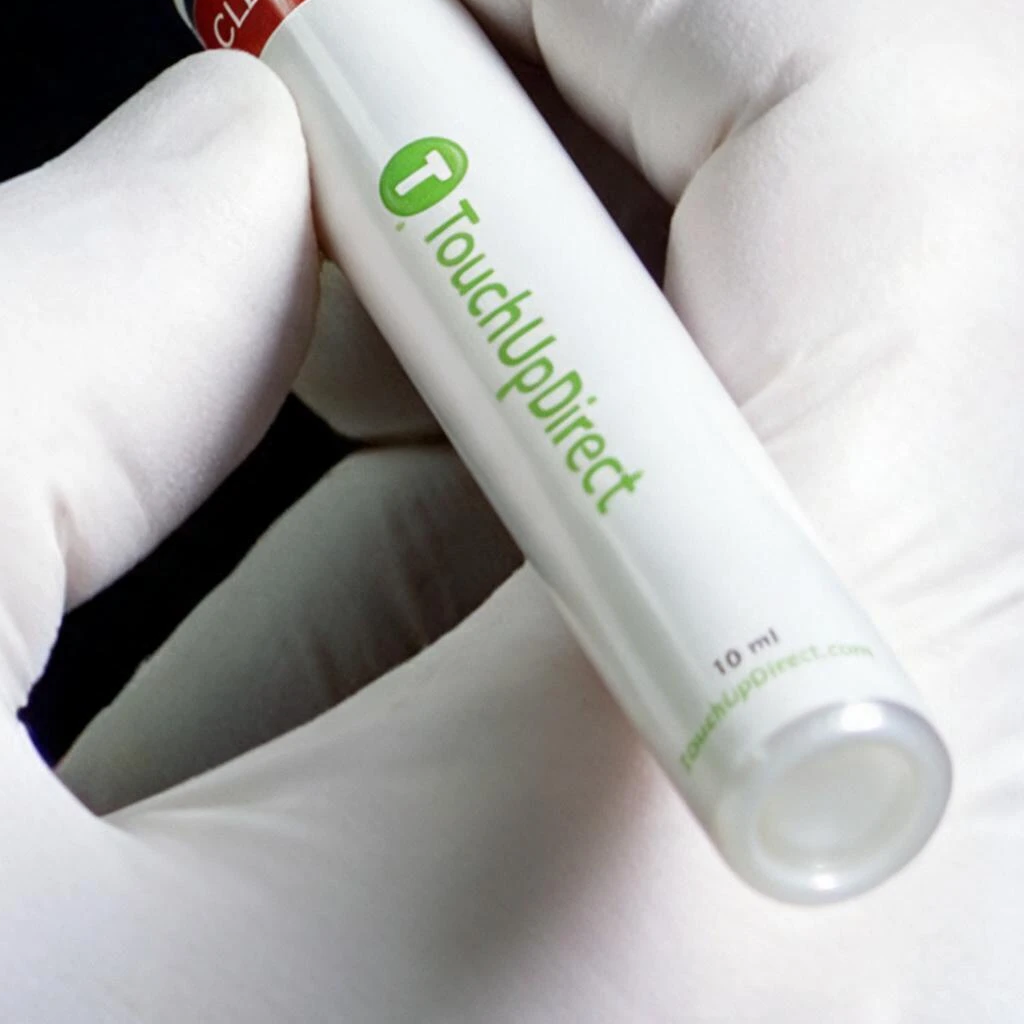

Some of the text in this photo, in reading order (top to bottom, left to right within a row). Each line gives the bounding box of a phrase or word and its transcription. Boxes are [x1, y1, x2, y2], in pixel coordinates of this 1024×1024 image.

[424, 198, 644, 515] TouchUpDirect
[713, 627, 779, 675] 10 ml
